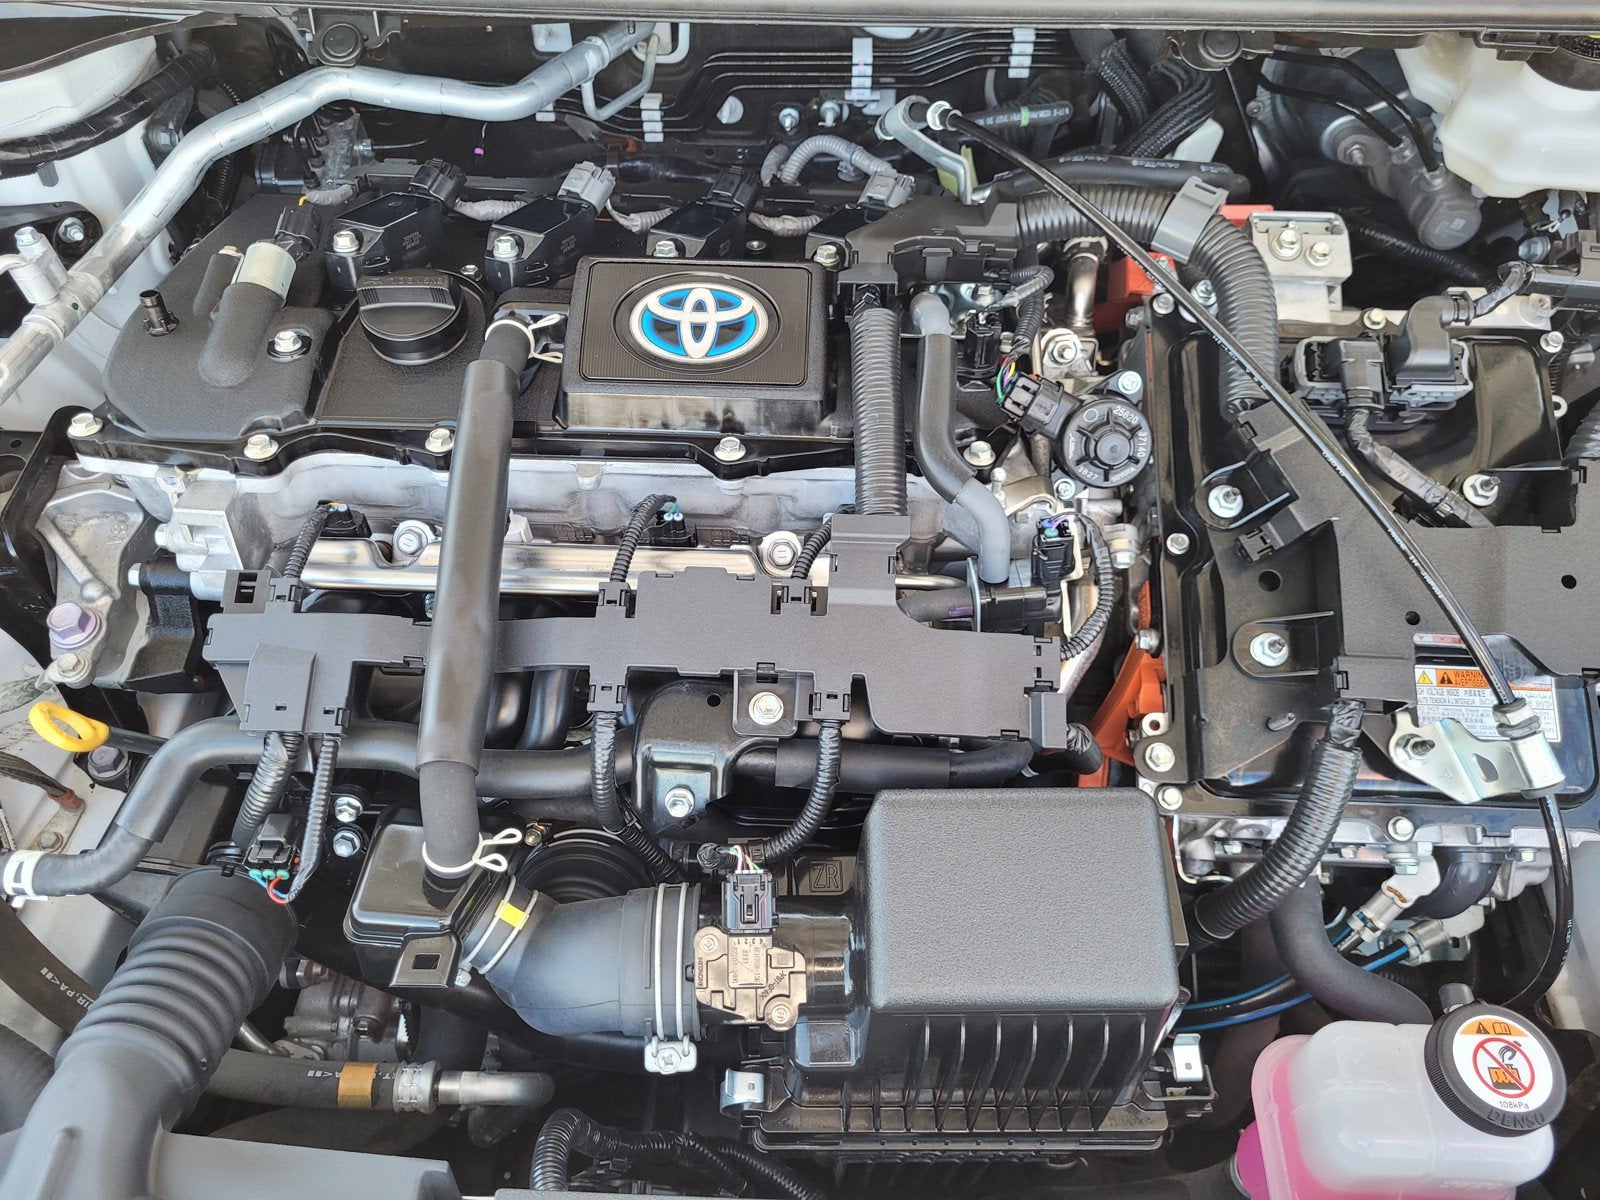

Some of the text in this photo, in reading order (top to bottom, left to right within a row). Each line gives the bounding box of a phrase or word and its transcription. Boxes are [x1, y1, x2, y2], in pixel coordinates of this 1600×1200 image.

[1113, 405, 1139, 424] 25620
[1137, 431, 1148, 458] 37140
[1453, 670, 1485, 680] WARNIN
[813, 864, 839, 889] ZR
[1499, 1101, 1530, 1110] 108kPa
